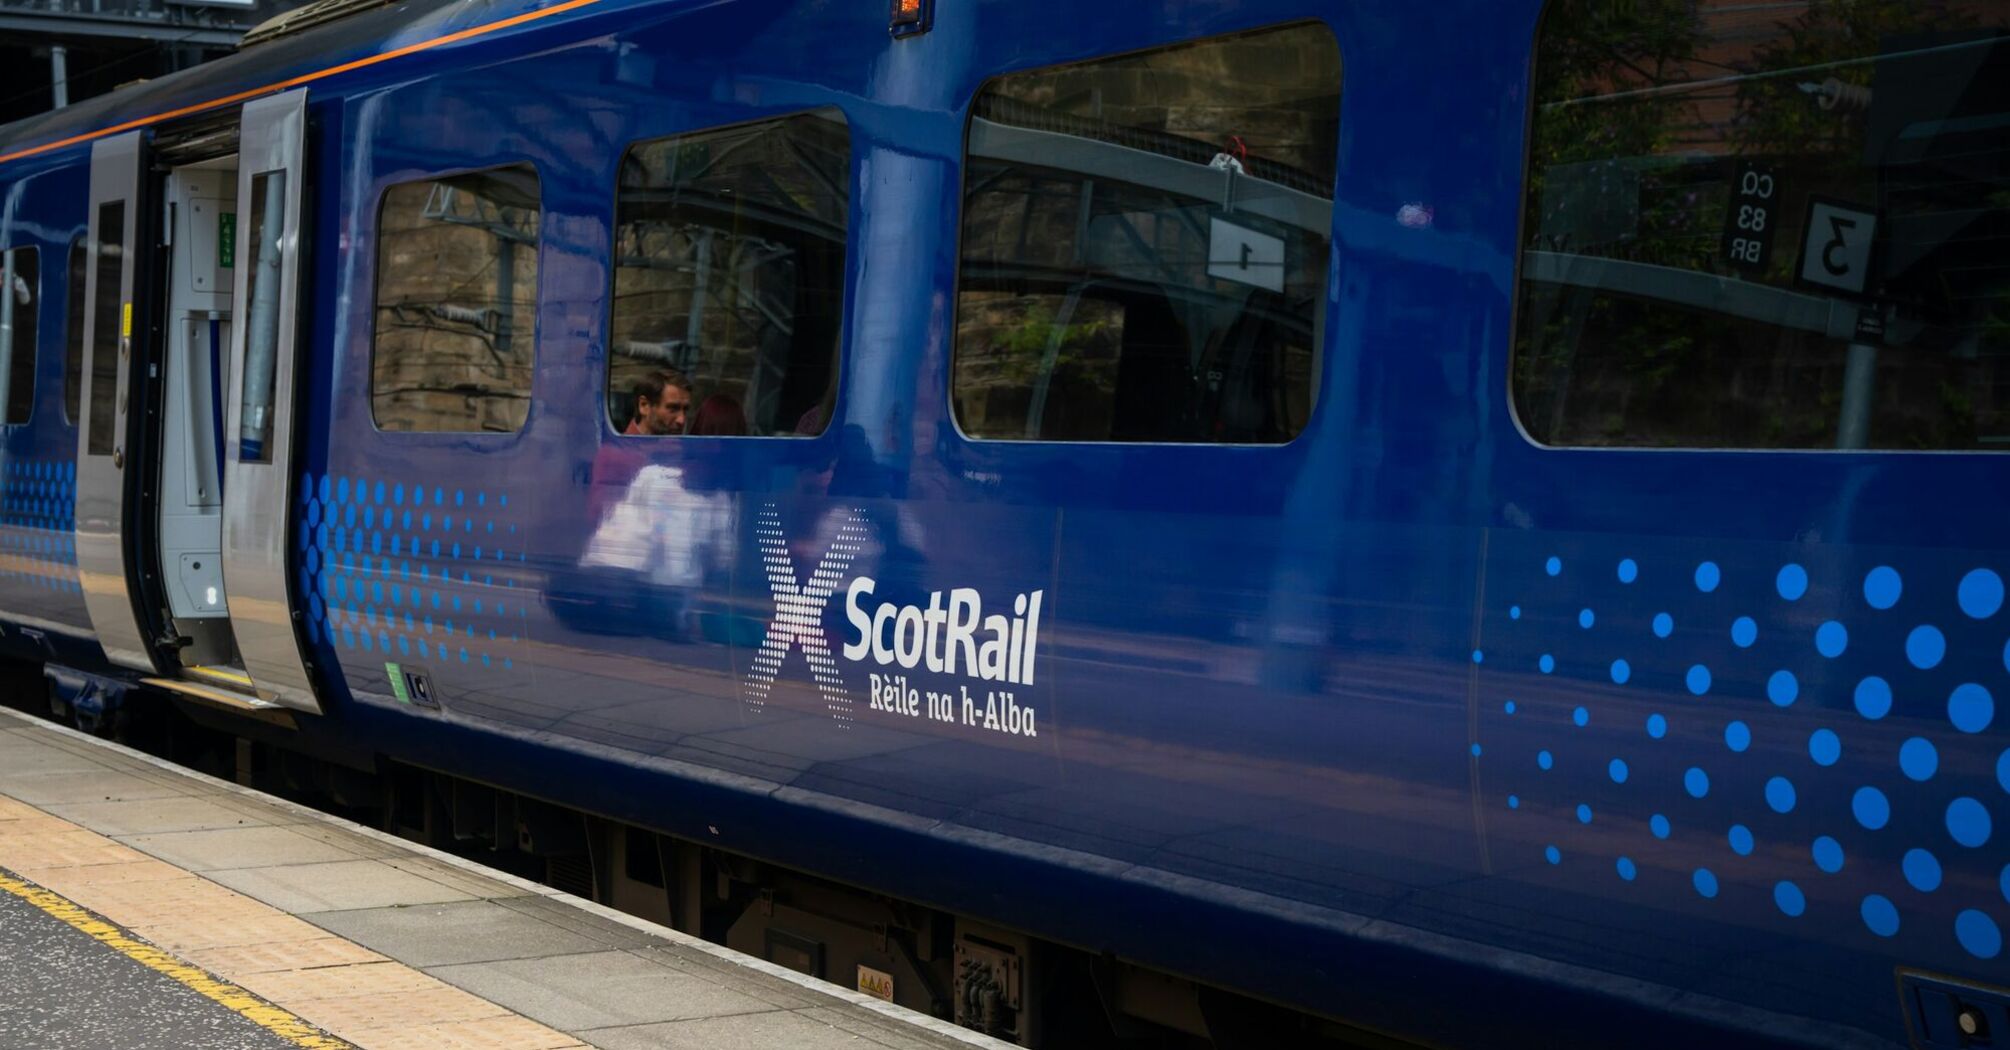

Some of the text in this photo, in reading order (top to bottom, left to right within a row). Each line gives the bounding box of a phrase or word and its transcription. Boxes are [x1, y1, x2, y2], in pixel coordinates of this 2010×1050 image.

[843, 576, 1043, 685] ScotRail
[869, 673, 1037, 737] Rèile na h-Alba
